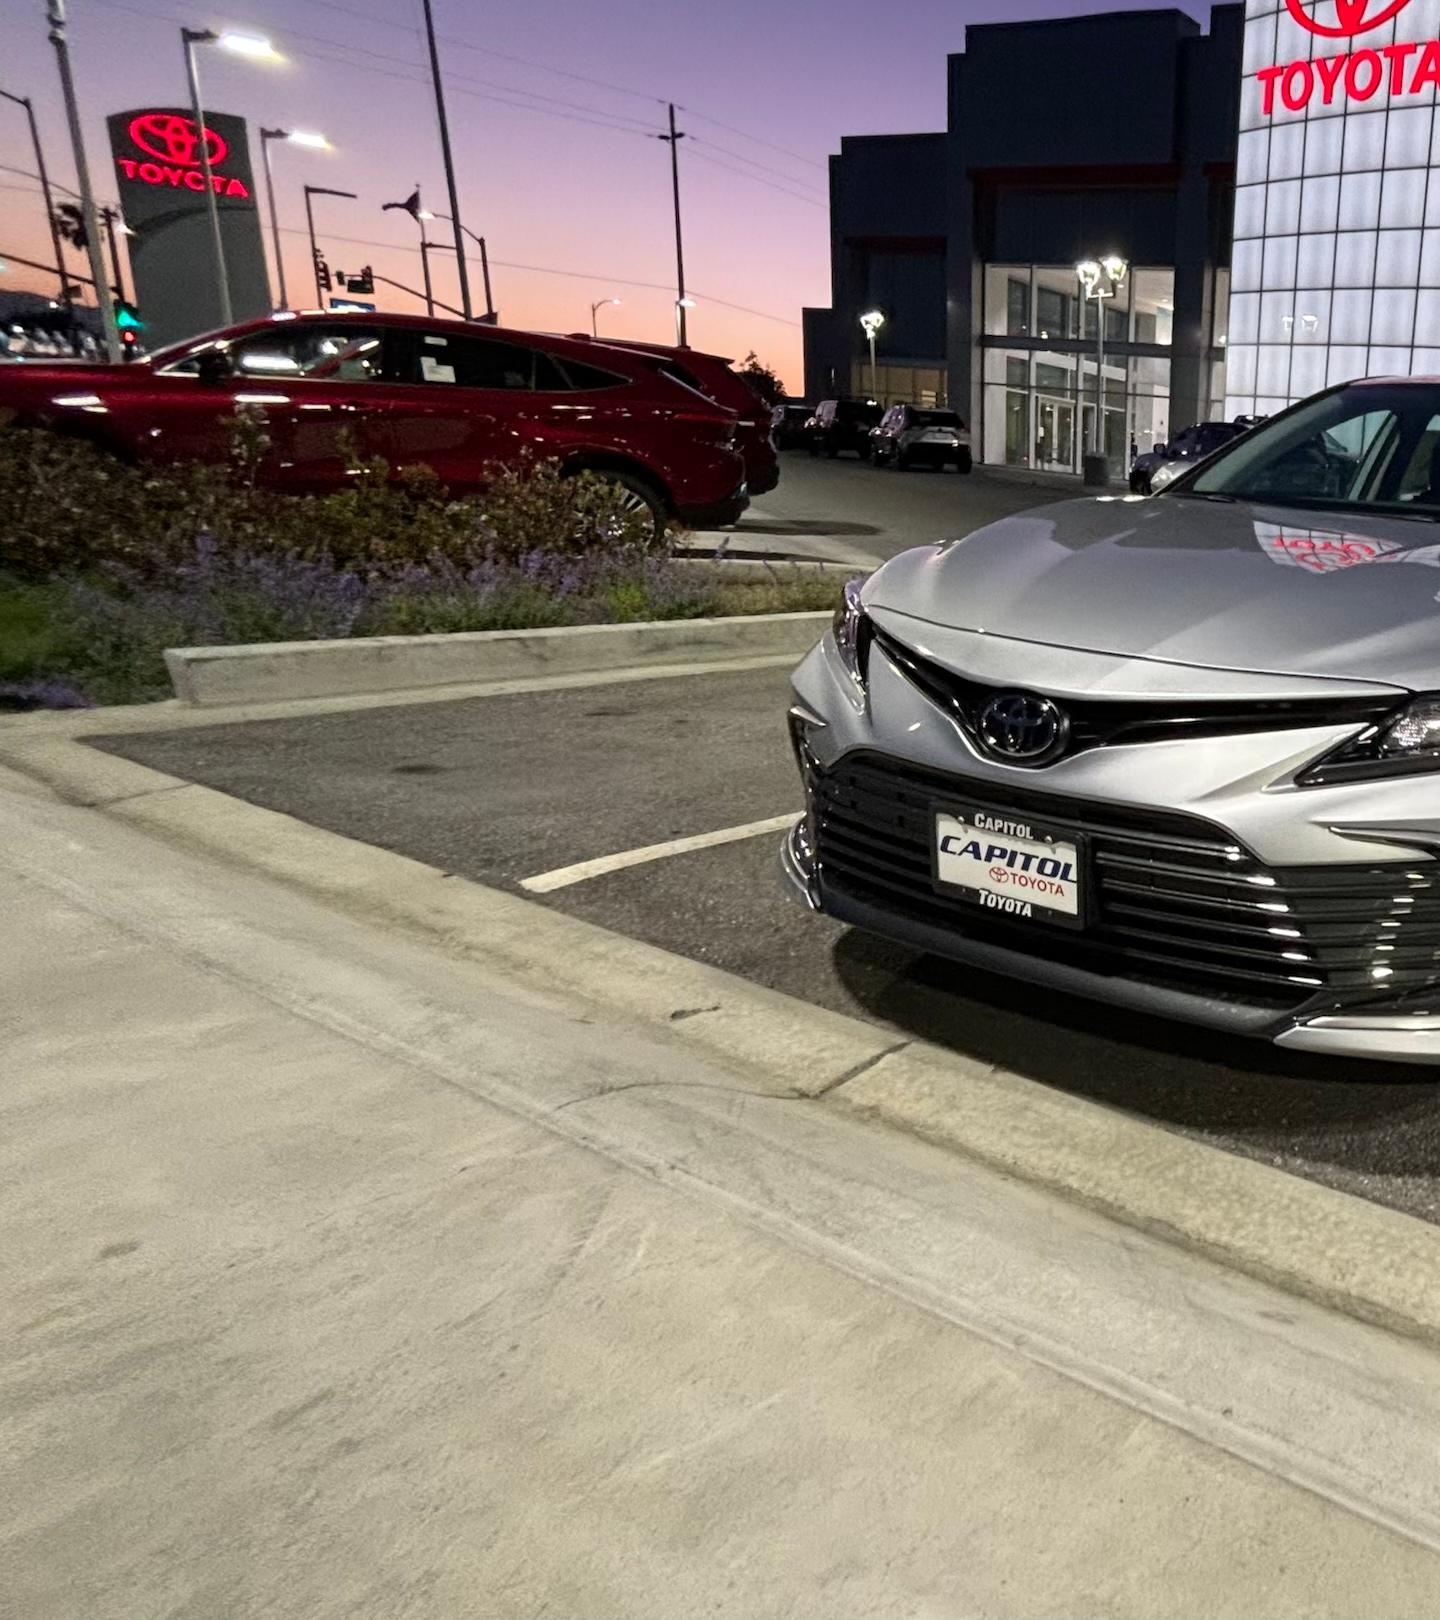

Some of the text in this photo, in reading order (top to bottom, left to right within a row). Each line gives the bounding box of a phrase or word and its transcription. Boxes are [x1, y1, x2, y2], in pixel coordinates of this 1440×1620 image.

[119, 159, 249, 198] TOYOTA
[974, 813, 1034, 840] CAPITOL
[940, 835, 1078, 884] CAPITOL
[1010, 872, 1065, 897] TOYOTA
[978, 889, 1032, 918] TOYOTA
